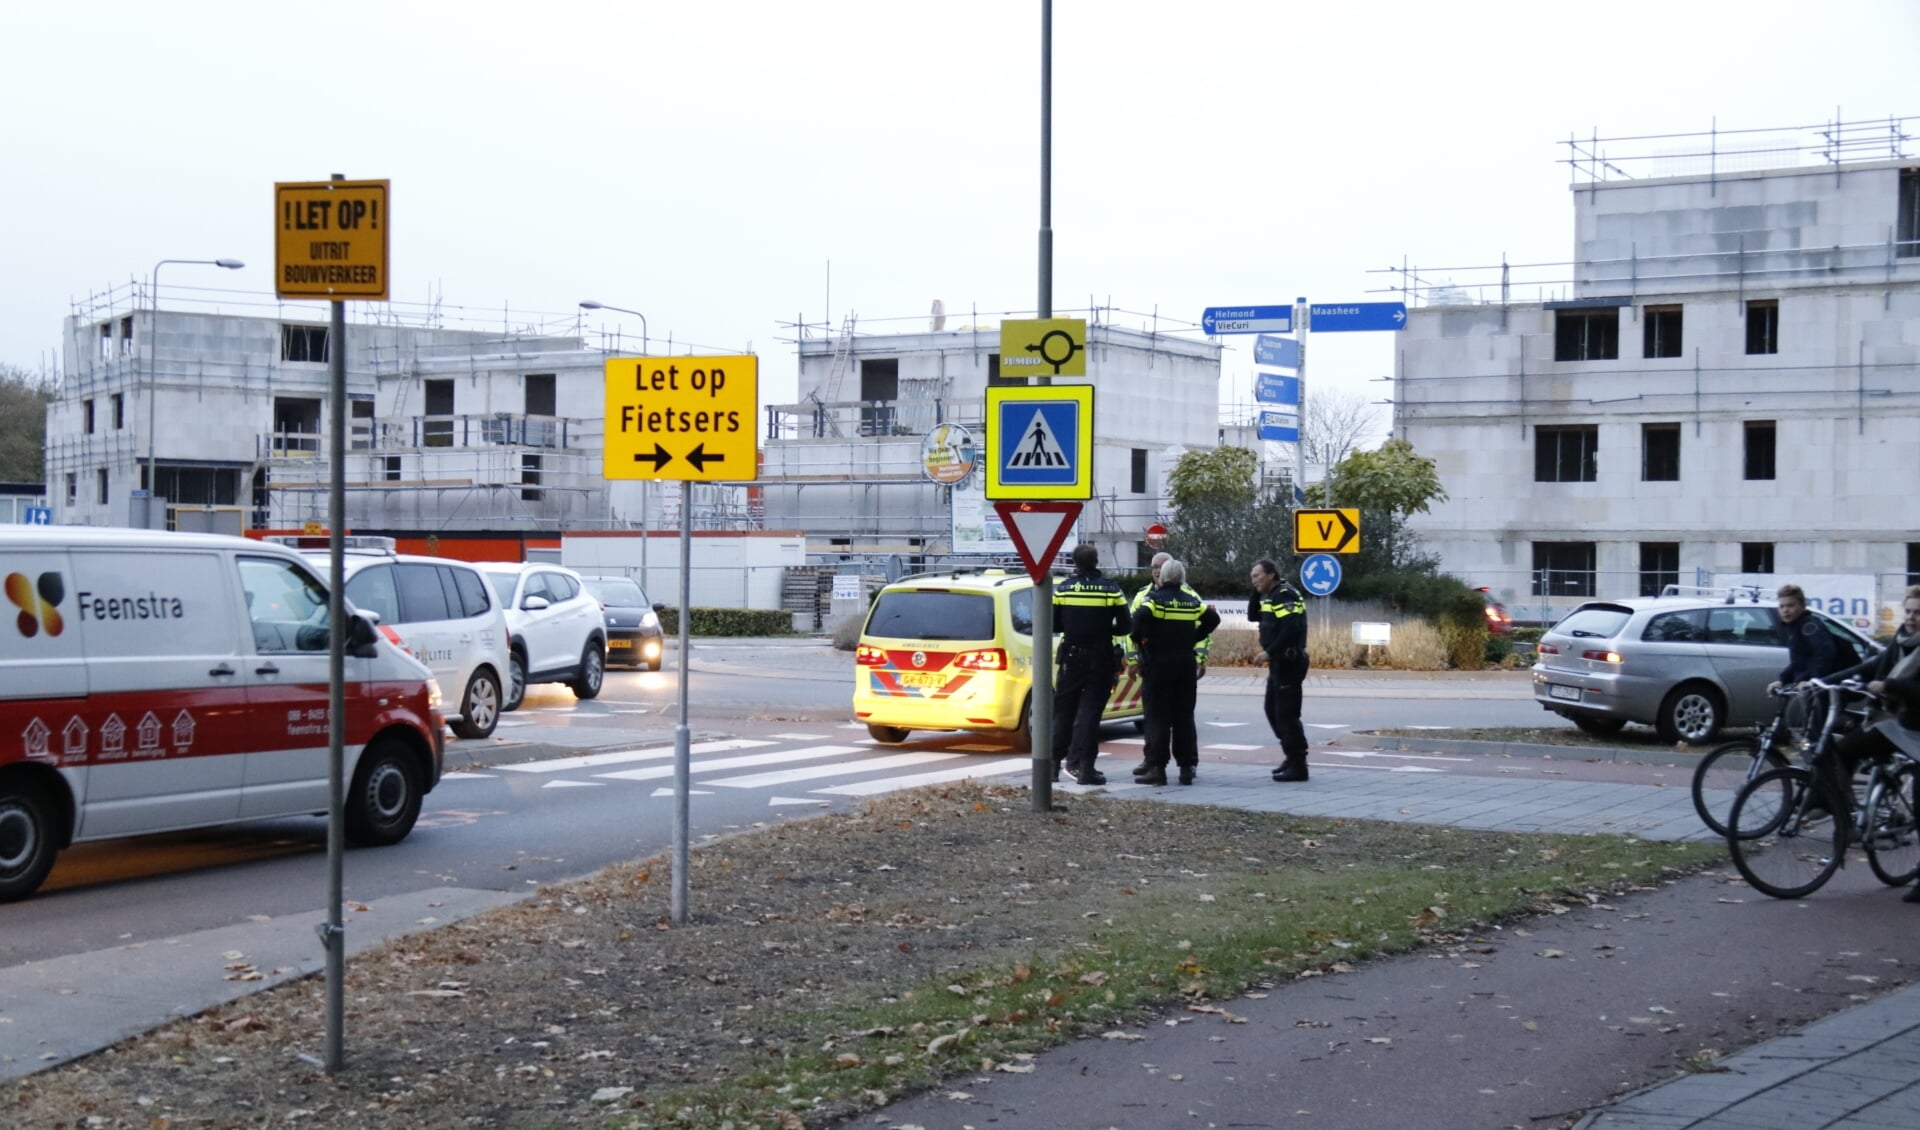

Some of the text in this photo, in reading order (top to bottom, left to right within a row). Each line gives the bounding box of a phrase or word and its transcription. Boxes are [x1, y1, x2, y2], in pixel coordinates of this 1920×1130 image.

[310, 241, 350, 260] UITRIT
[284, 265, 377, 284] BOUWVERKEER
[1215, 310, 1255, 319] Helmond
[1312, 307, 1360, 316] Maashees
[1217, 321, 1249, 330] VieCuri
[1004, 357, 1041, 366] JUMBO
[636, 364, 725, 398] Let op
[621, 404, 740, 433] Fietsers
[1317, 520, 1334, 542] V
[77, 591, 183, 621] Feenstra
